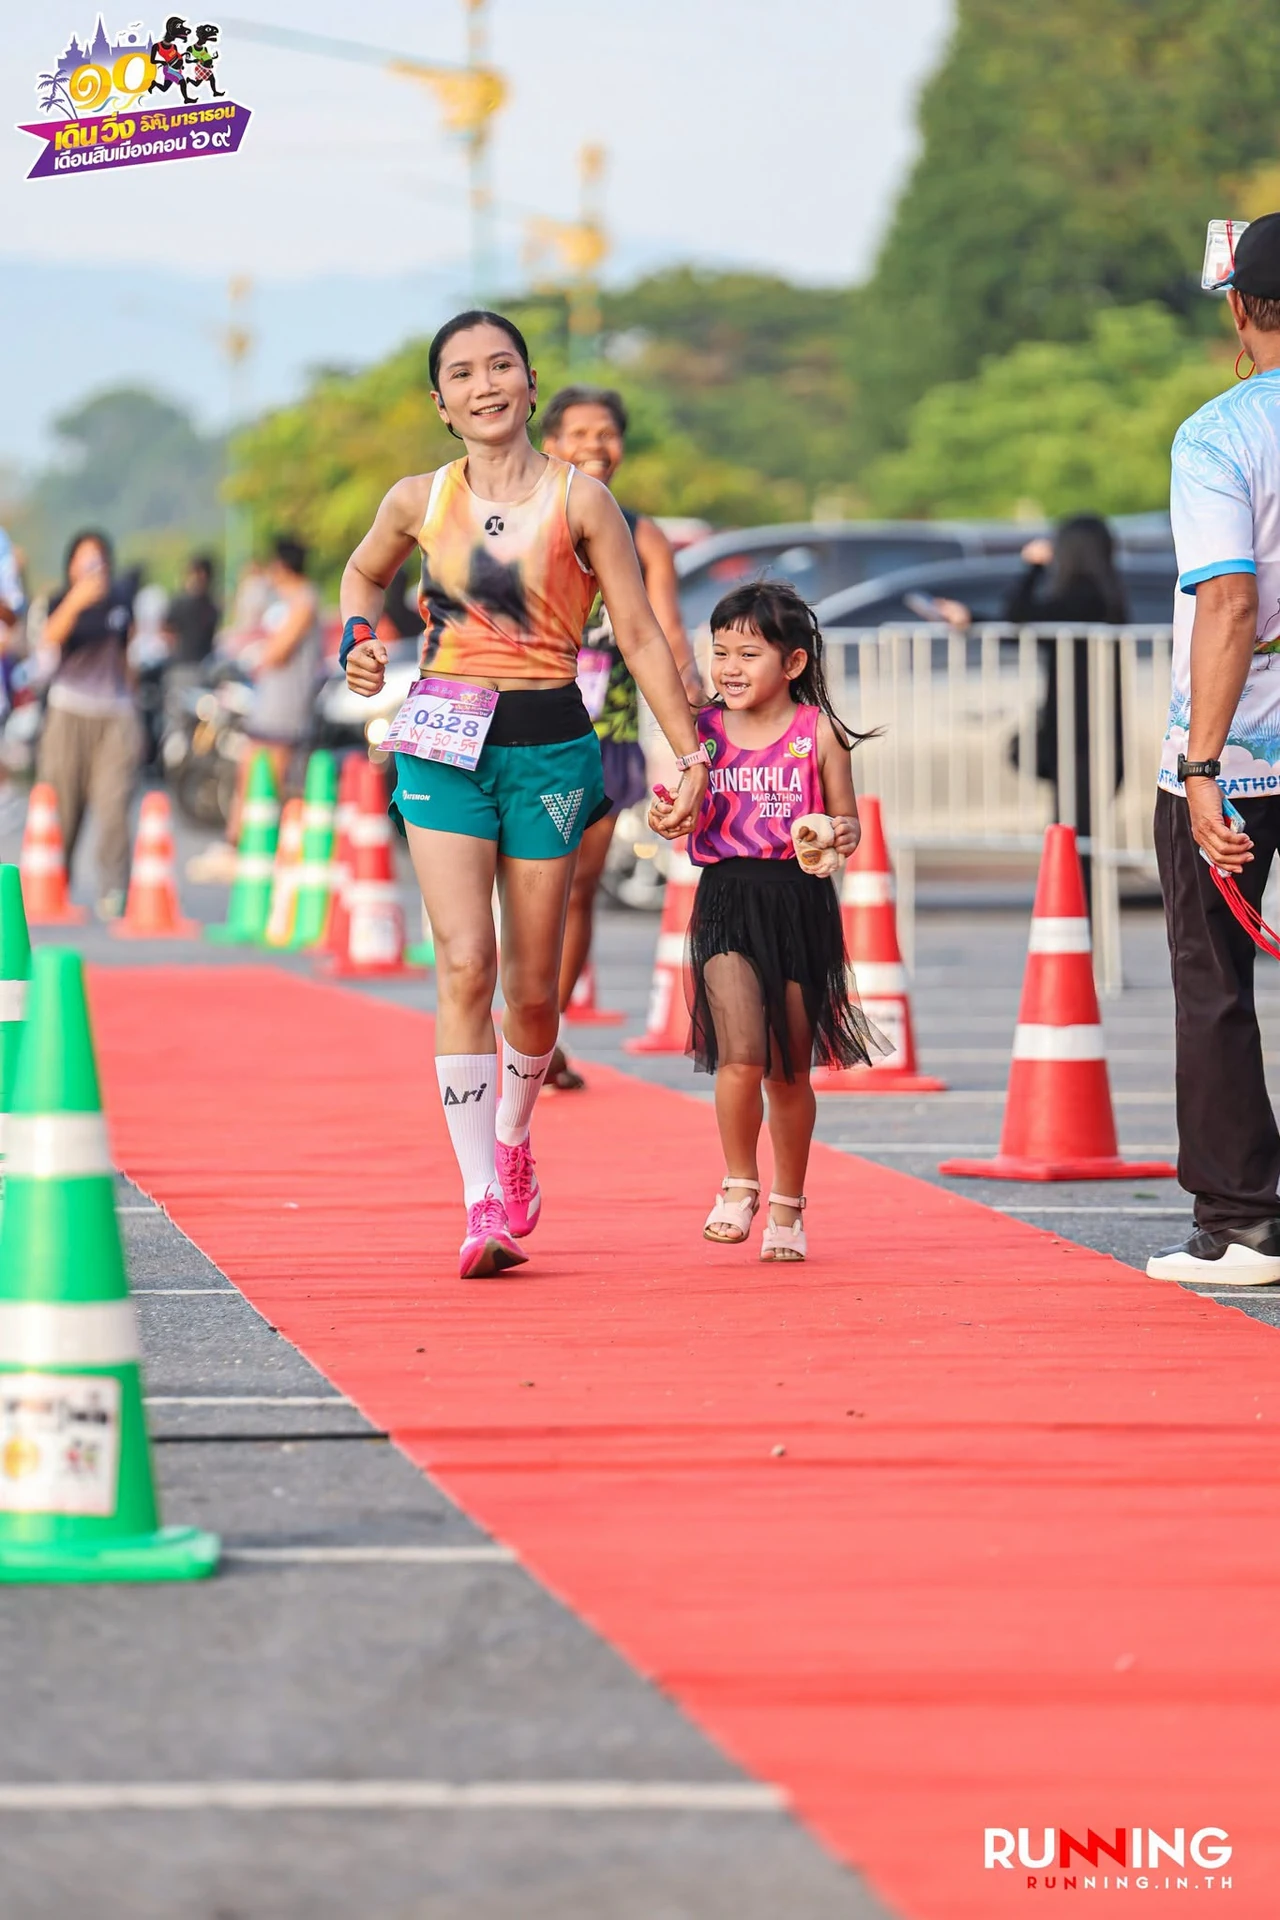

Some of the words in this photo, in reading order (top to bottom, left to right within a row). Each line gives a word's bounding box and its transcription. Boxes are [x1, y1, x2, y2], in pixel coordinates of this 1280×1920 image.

[414, 709, 479, 738] 0328
[710, 767, 802, 794] SONGKHLA
[751, 793, 803, 803] MARATHON
[759, 802, 792, 818] 2026
[444, 1082, 487, 1105] Ari
